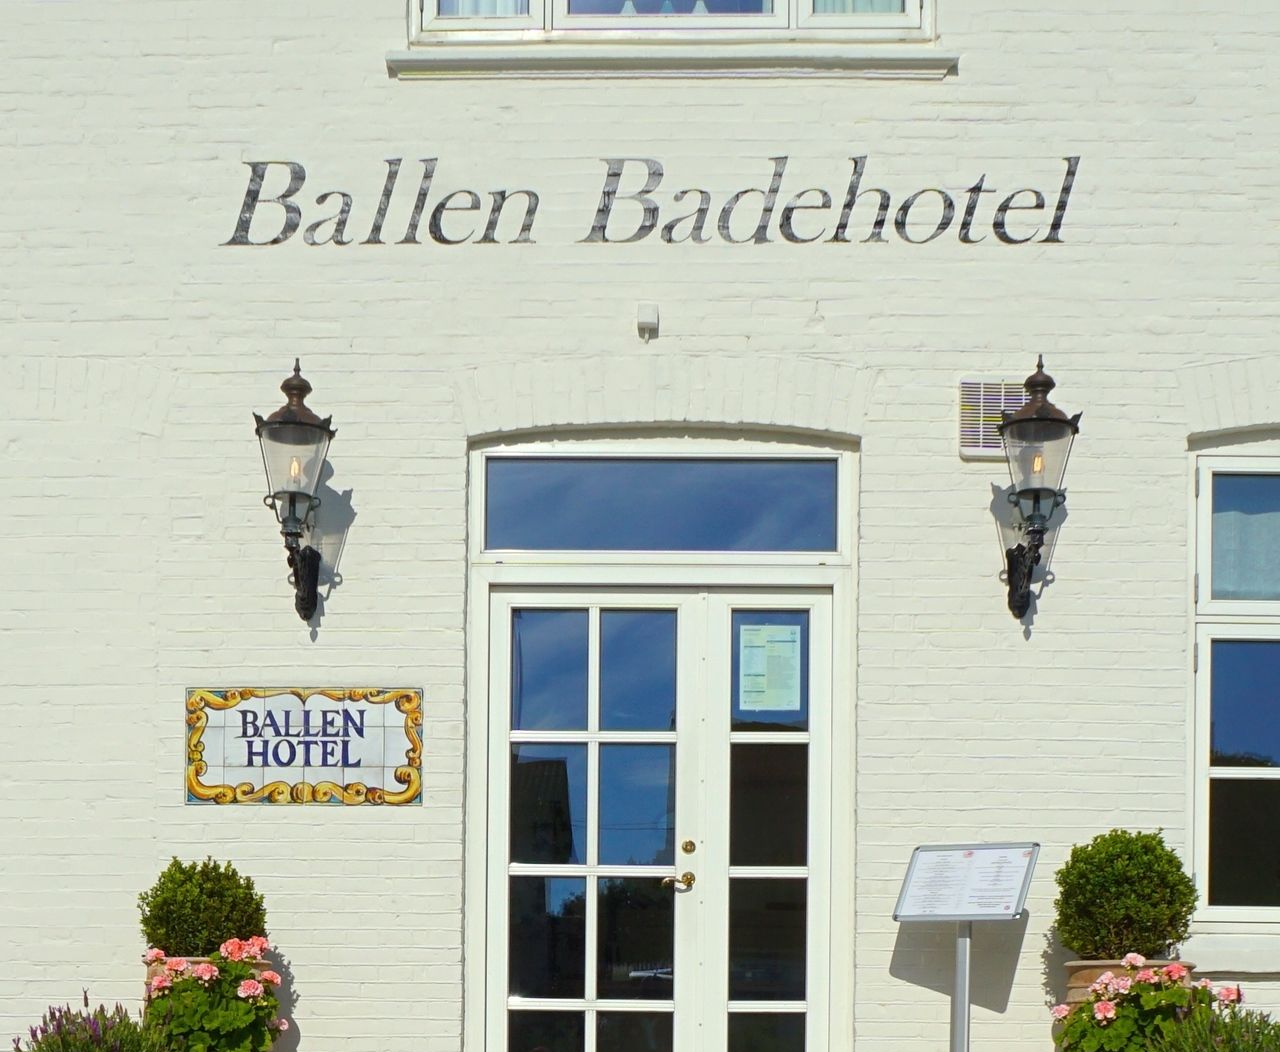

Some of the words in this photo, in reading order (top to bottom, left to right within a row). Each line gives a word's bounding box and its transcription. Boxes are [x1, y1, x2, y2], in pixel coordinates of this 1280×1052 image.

[218, 157, 539, 246] Ballen
[575, 155, 1081, 245] Badehotel
[236, 708, 367, 739] BALLEN
[244, 739, 362, 768] HOTEL
